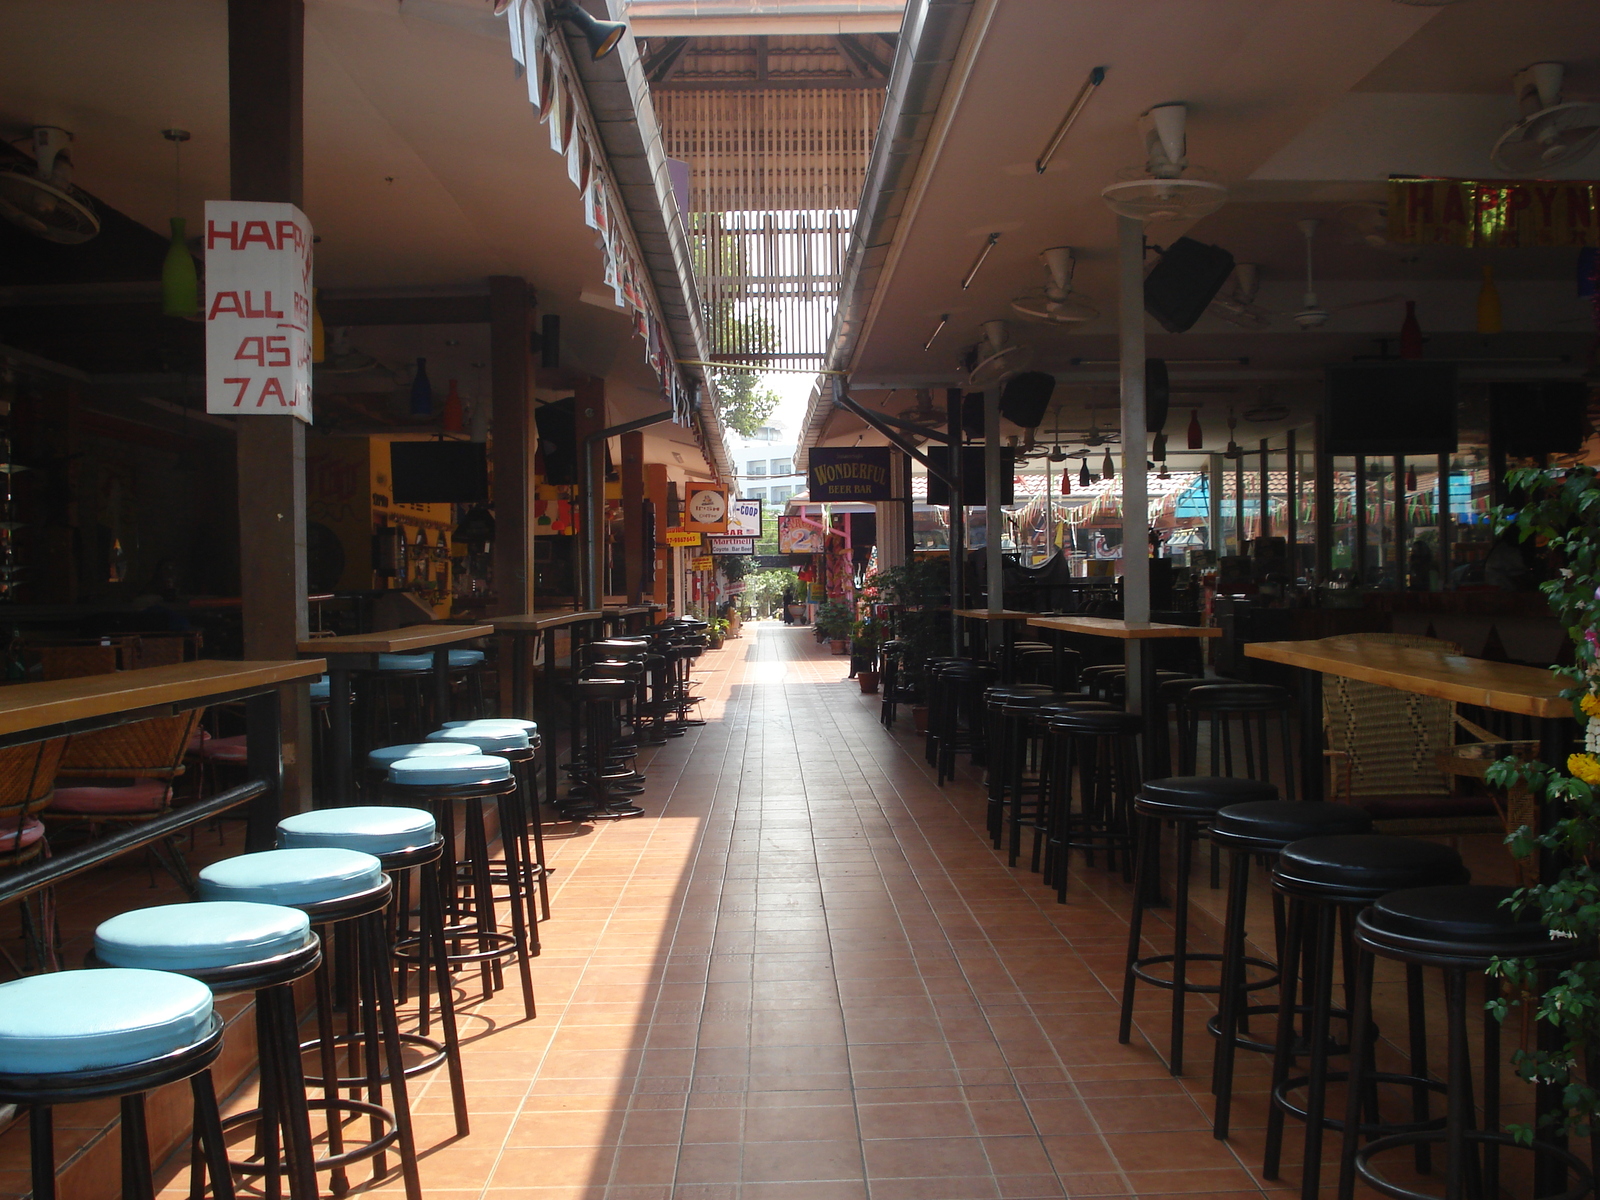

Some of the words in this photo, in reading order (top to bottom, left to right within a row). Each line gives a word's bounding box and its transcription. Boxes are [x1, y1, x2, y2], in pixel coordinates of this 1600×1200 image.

[208, 290, 284, 321] ALL
[234, 335, 291, 368] 45
[813, 462, 887, 486] WONDERFUL
[828, 485, 852, 494] BEER
[854, 485, 872, 494] BAR
